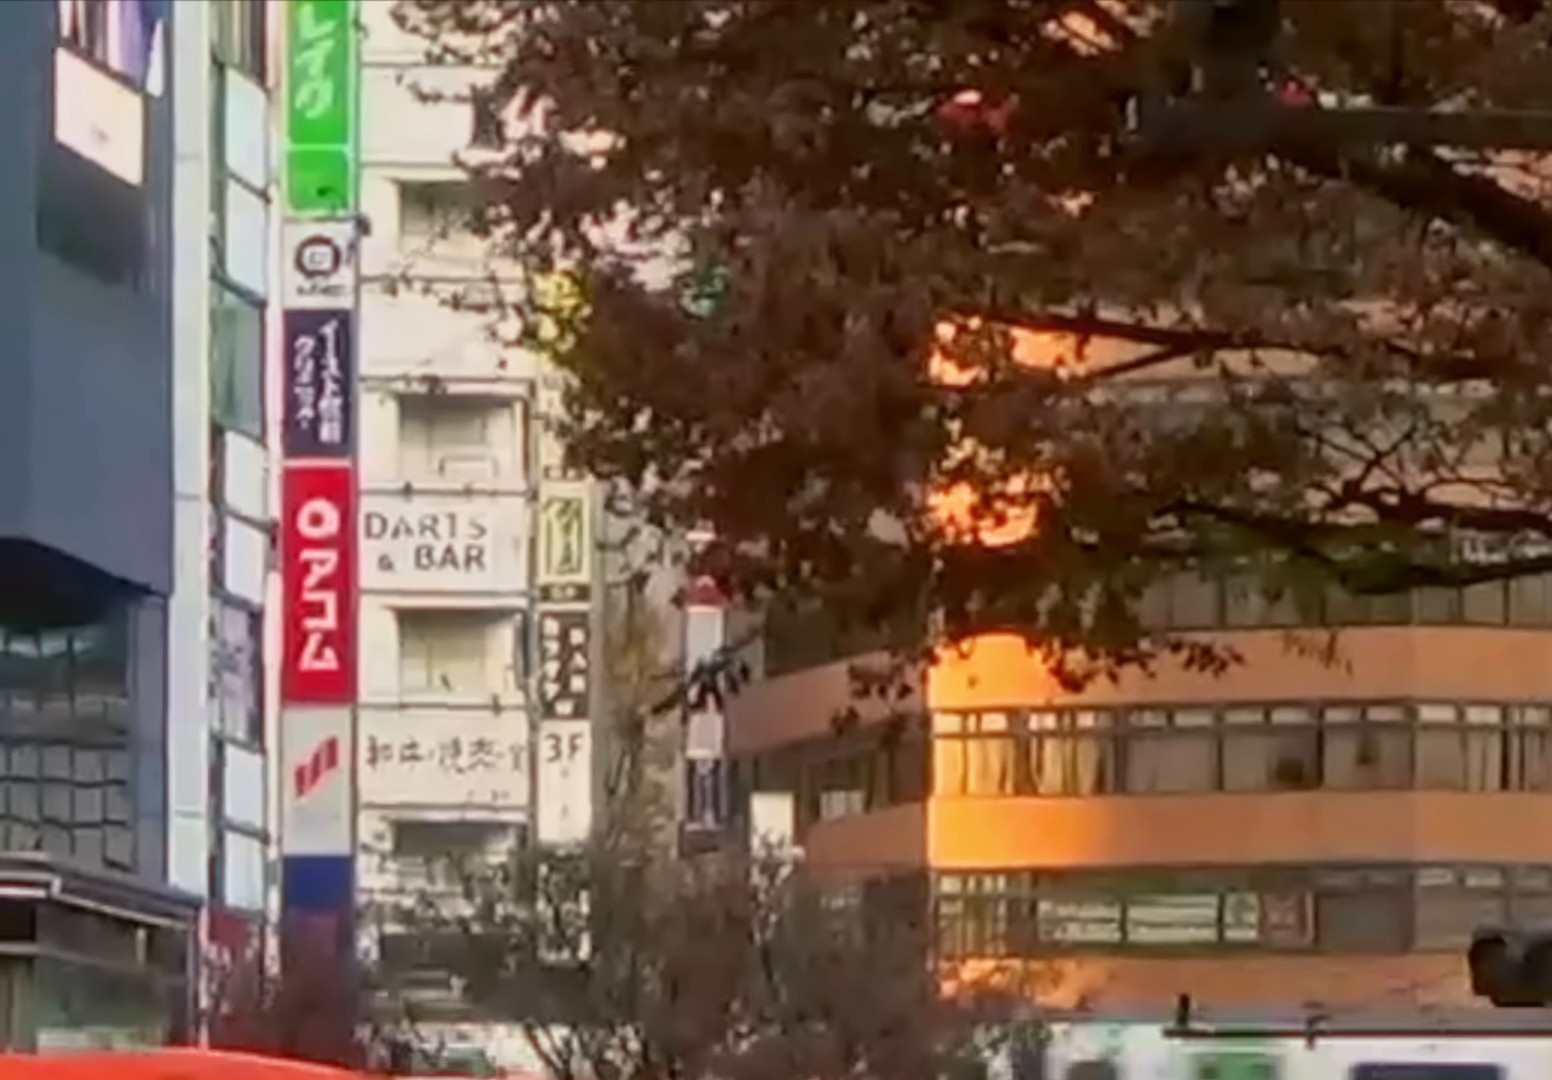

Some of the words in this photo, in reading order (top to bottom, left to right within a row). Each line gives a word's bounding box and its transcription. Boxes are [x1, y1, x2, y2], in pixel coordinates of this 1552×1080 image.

[364, 511, 488, 540] DARTS
[413, 544, 487, 572] BAR
[299, 550, 340, 672] アコム
[543, 733, 584, 763] 3F
